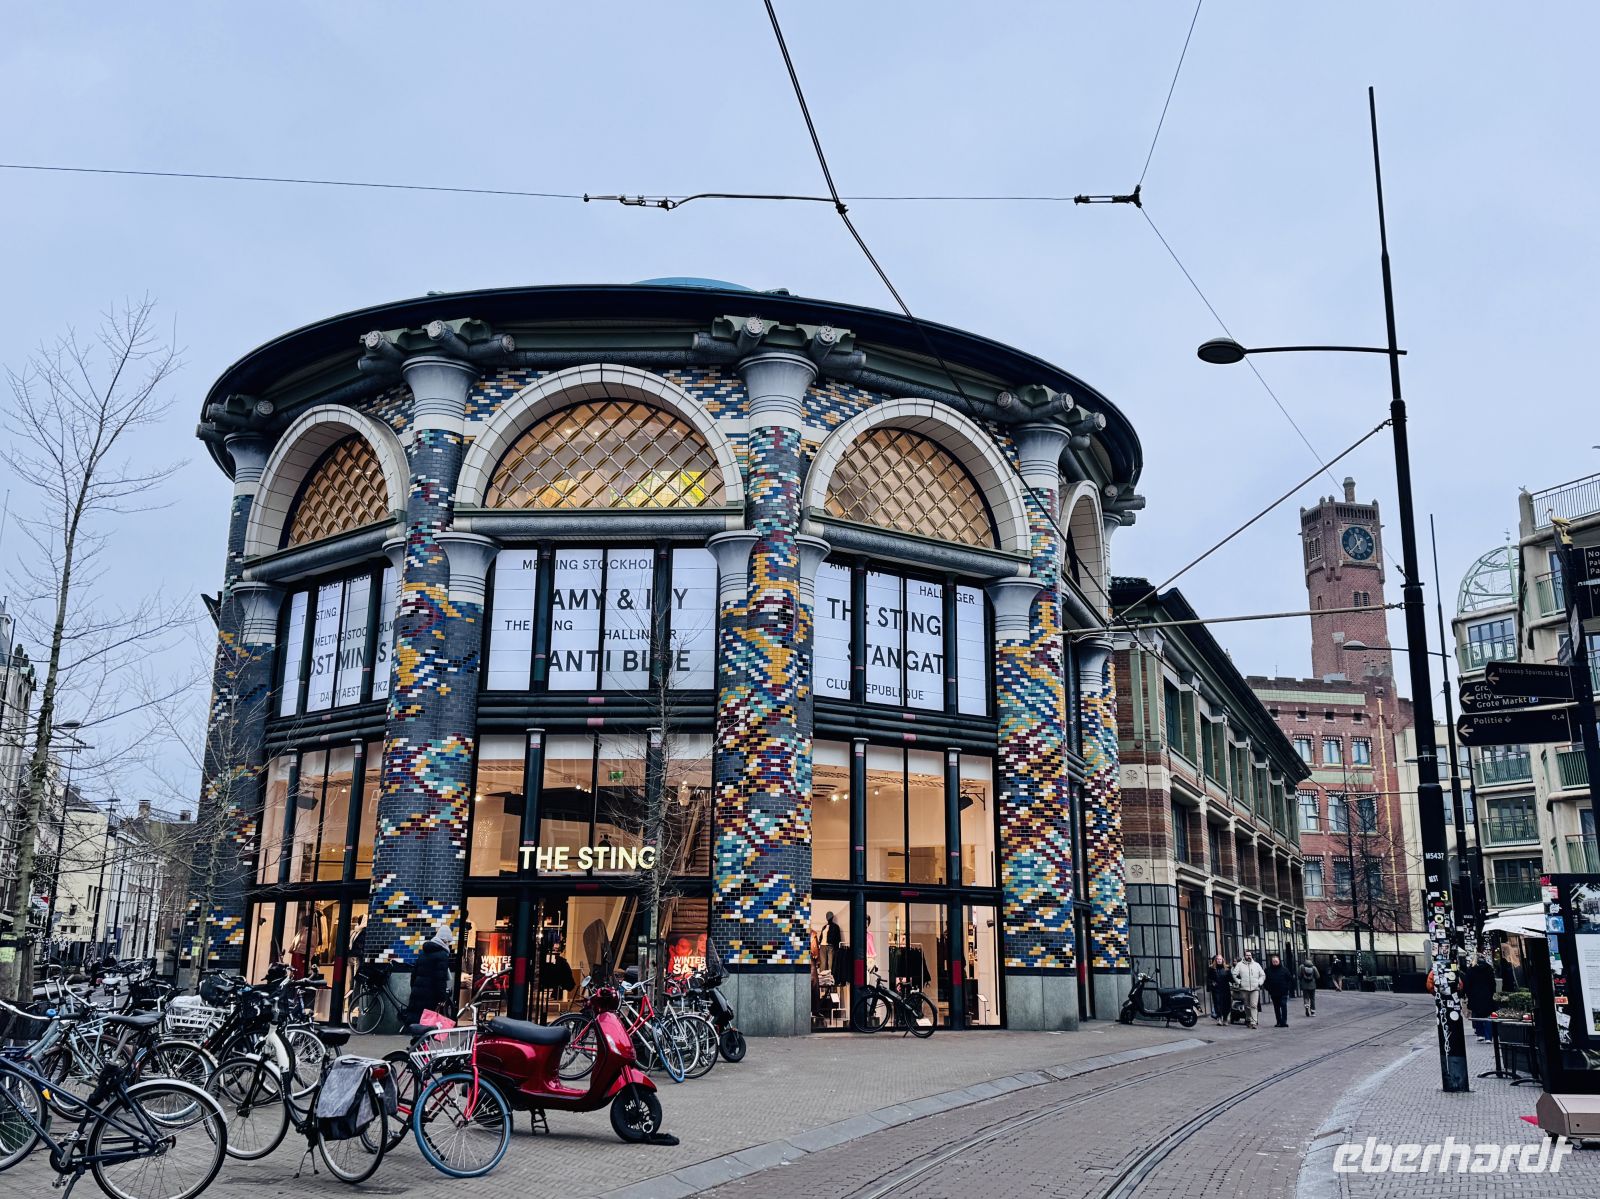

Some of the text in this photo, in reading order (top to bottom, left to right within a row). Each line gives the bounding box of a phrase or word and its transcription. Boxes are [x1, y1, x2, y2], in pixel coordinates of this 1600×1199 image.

[583, 560, 654, 569] STOCKHOL
[553, 588, 688, 610] AMY & IY
[920, 586, 975, 604] HALLGER
[505, 620, 530, 631] THE
[604, 629, 677, 640] HALLINR
[339, 642, 387, 671] MINS
[550, 650, 611, 672] ANTI
[1476, 692, 1492, 701] City
[1476, 700, 1500, 709] Grote
[1502, 697, 1527, 706] Markt
[1473, 717, 1503, 725] Politie
[519, 847, 656, 870] THE STING
[674, 956, 706, 964] WINTER
